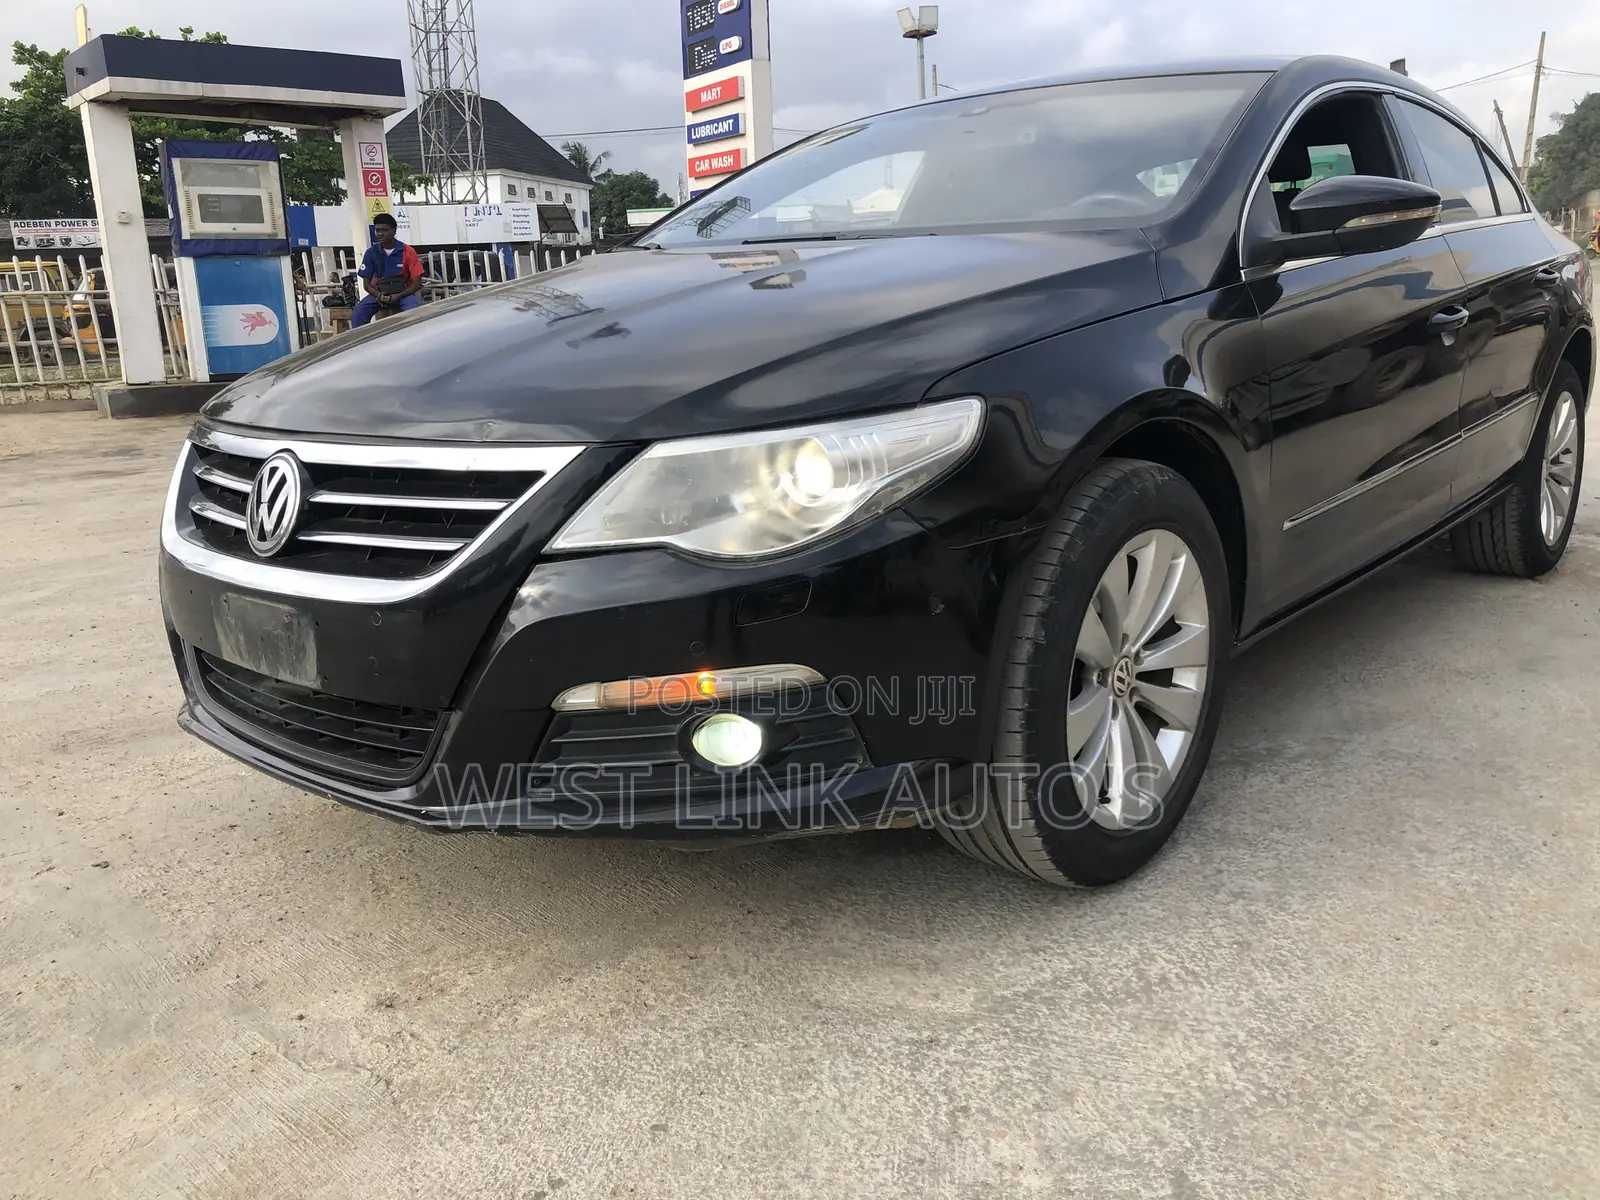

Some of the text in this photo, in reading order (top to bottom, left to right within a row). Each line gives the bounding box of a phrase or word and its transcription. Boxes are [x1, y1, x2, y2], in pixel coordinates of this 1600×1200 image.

[720, 0, 735, 11] DIESEL
[722, 41, 732, 51] LPG
[700, 86, 722, 103] MART
[691, 119, 734, 139] LUBRICANT
[694, 154, 734, 172] CAR WASH
[13, 220, 52, 229] ADEBEN
[54, 220, 89, 228] POWER
